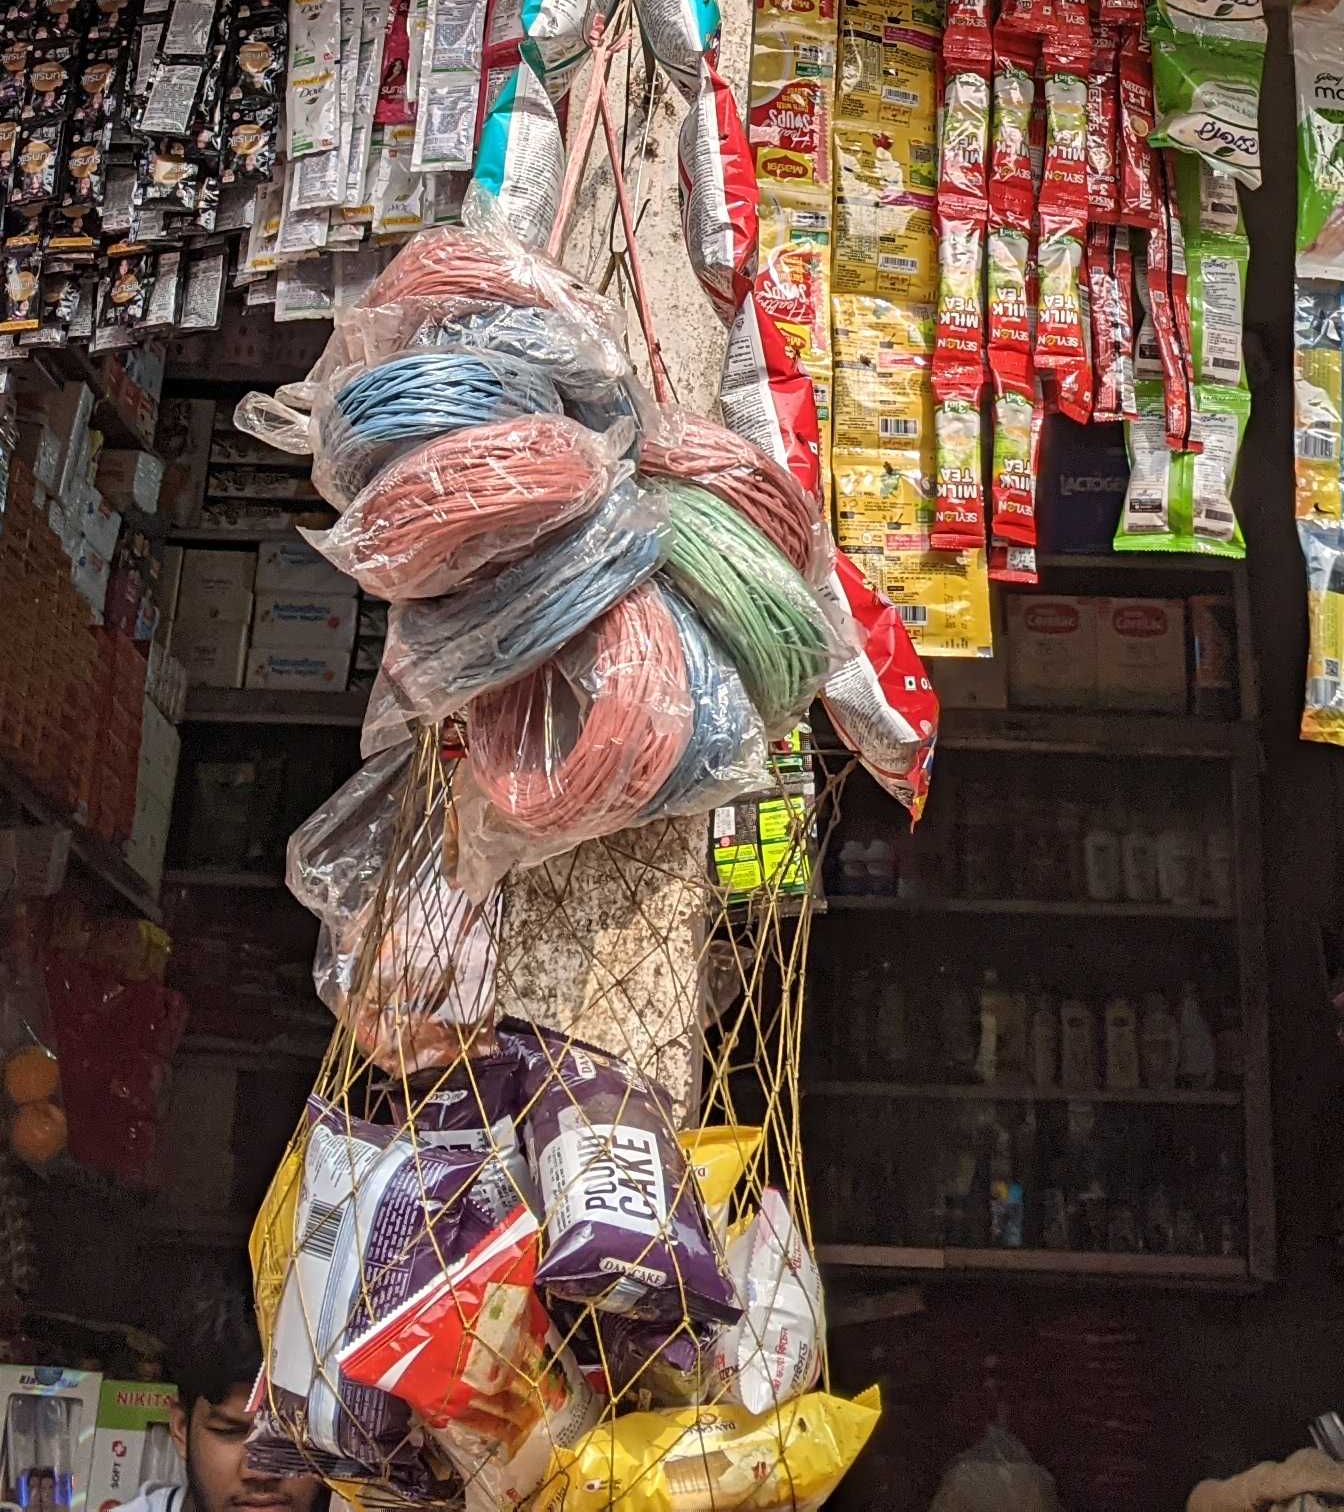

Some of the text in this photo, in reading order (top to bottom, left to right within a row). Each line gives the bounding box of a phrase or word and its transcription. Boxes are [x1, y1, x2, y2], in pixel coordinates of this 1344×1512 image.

[1048, 145, 1085, 161] MILK
[1044, 170, 1085, 184] SEYLON
[995, 287, 1025, 303] TEA
[1044, 294, 1075, 310] TEA
[944, 296, 976, 312] TEA
[991, 301, 1029, 318] MILK
[939, 311, 979, 329] MILK
[1040, 308, 1078, 325] MILK
[991, 327, 1029, 342] SEYLON
[1038, 334, 1078, 347] SEYLON
[937, 338, 978, 351] SEYLON
[1005, 457, 1031, 475] TEA
[941, 467, 973, 484] TEA
[937, 483, 978, 500] MILK
[936, 510, 978, 524] SEYLON
[576, 1134, 618, 1213] POUND
[612, 1133, 657, 1221] CAKE
[111, 1461, 122, 1489] SOFT
